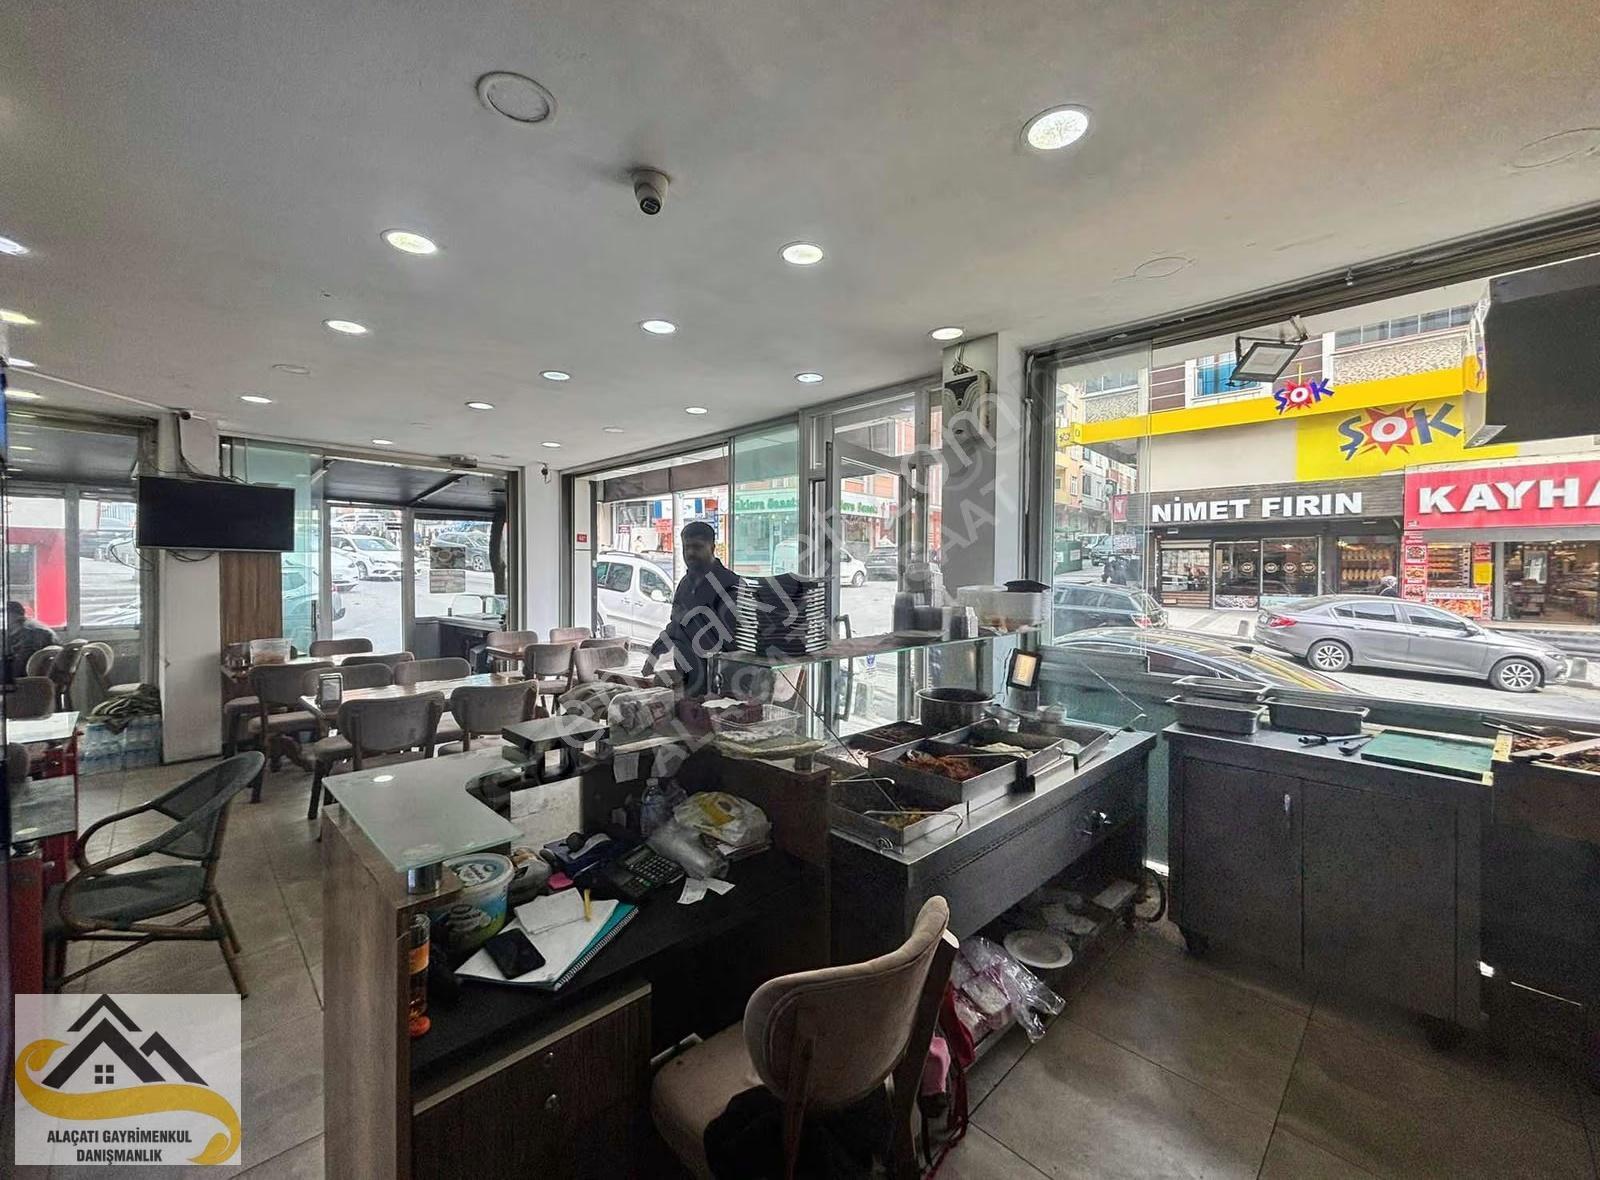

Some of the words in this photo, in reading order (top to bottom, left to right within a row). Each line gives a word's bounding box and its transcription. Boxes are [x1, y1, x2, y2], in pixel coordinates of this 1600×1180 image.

[1273, 377, 1336, 416] ŞOK
[1338, 402, 1462, 461] ŞOK
[1151, 496, 1251, 523] NİMET
[1261, 491, 1364, 518] FIRIN
